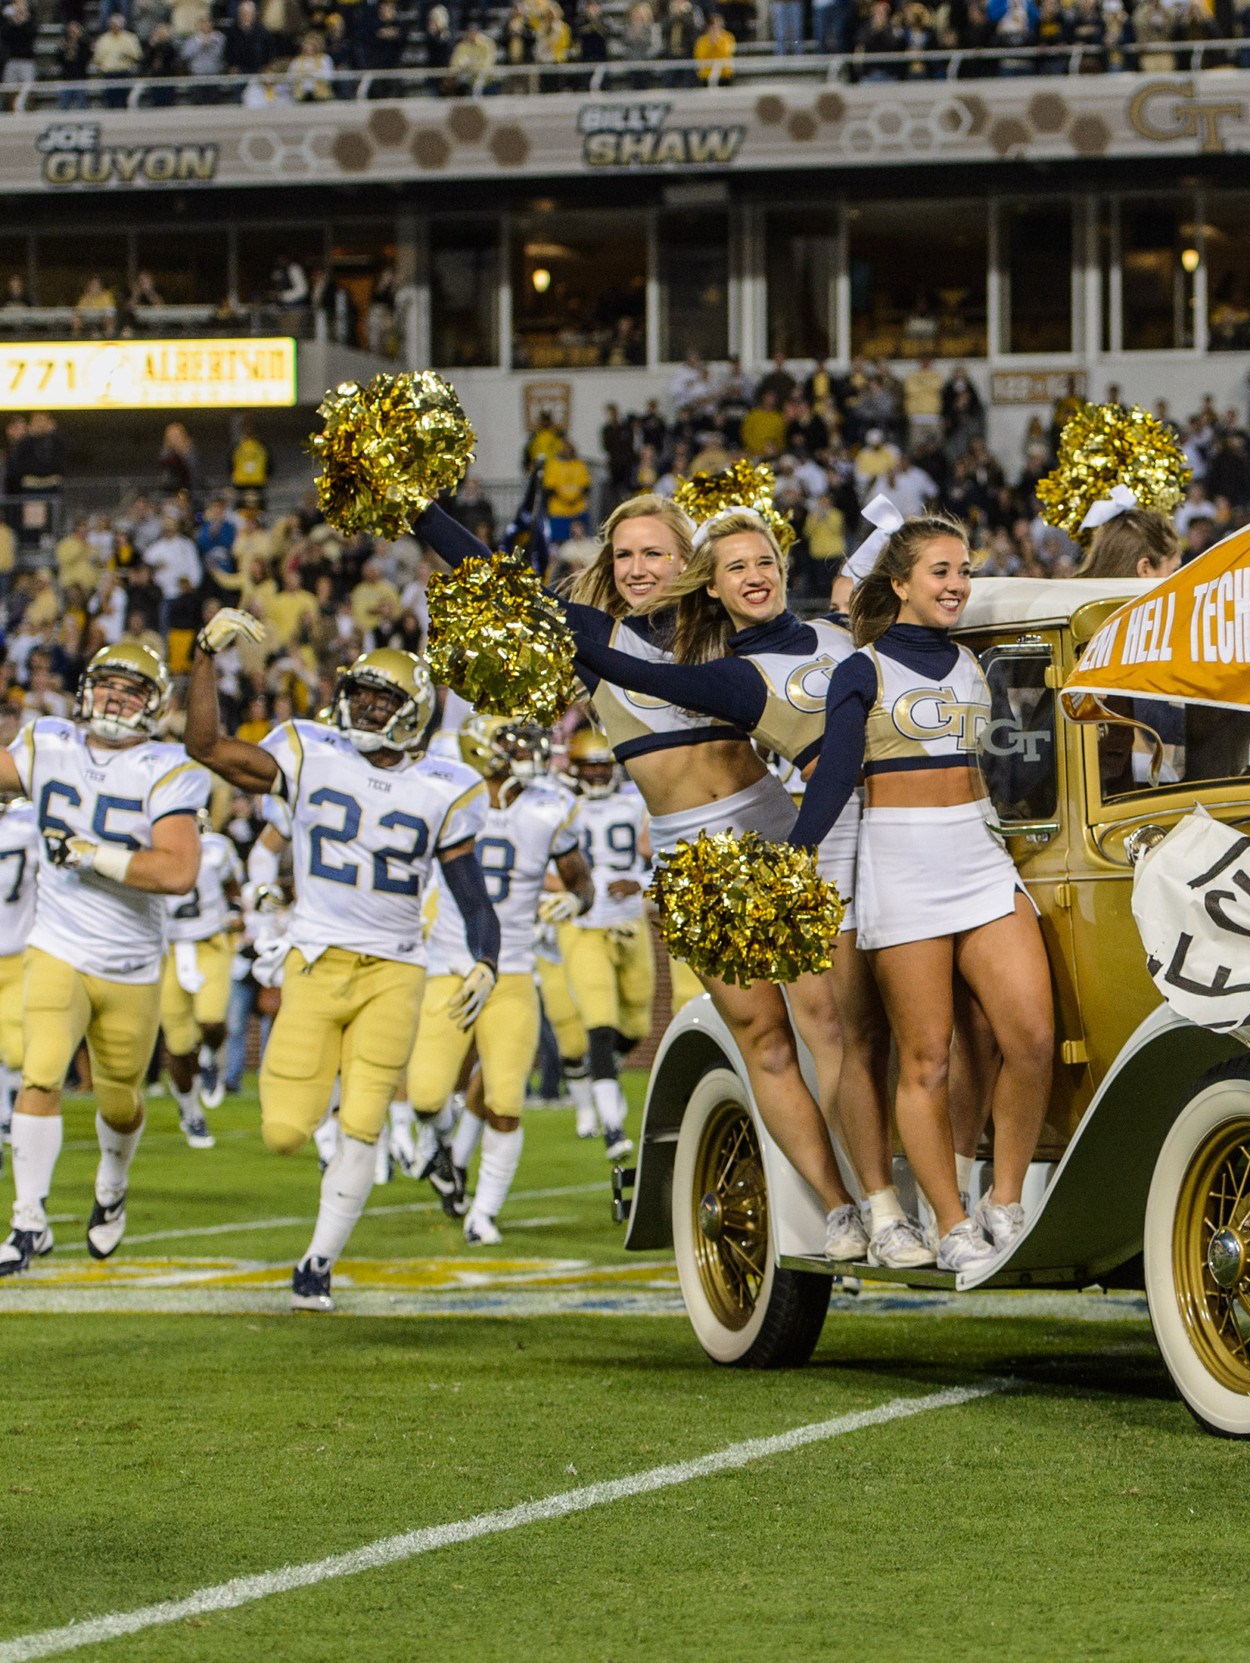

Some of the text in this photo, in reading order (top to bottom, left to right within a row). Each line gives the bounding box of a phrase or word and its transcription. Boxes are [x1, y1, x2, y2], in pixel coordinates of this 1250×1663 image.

[36, 123, 101, 150] JOE
[578, 103, 672, 132] BILLY
[1129, 80, 1243, 153] GT
[42, 144, 218, 184] GUYON
[585, 125, 746, 165] SHAW
[8, 360, 76, 390] 771
[1121, 592, 1176, 666] HELL
[892, 687, 991, 750] GT
[980, 718, 1050, 762] GT
[368, 777, 392, 793] TECH
[38, 778, 145, 866] 65
[308, 785, 431, 898] 22
